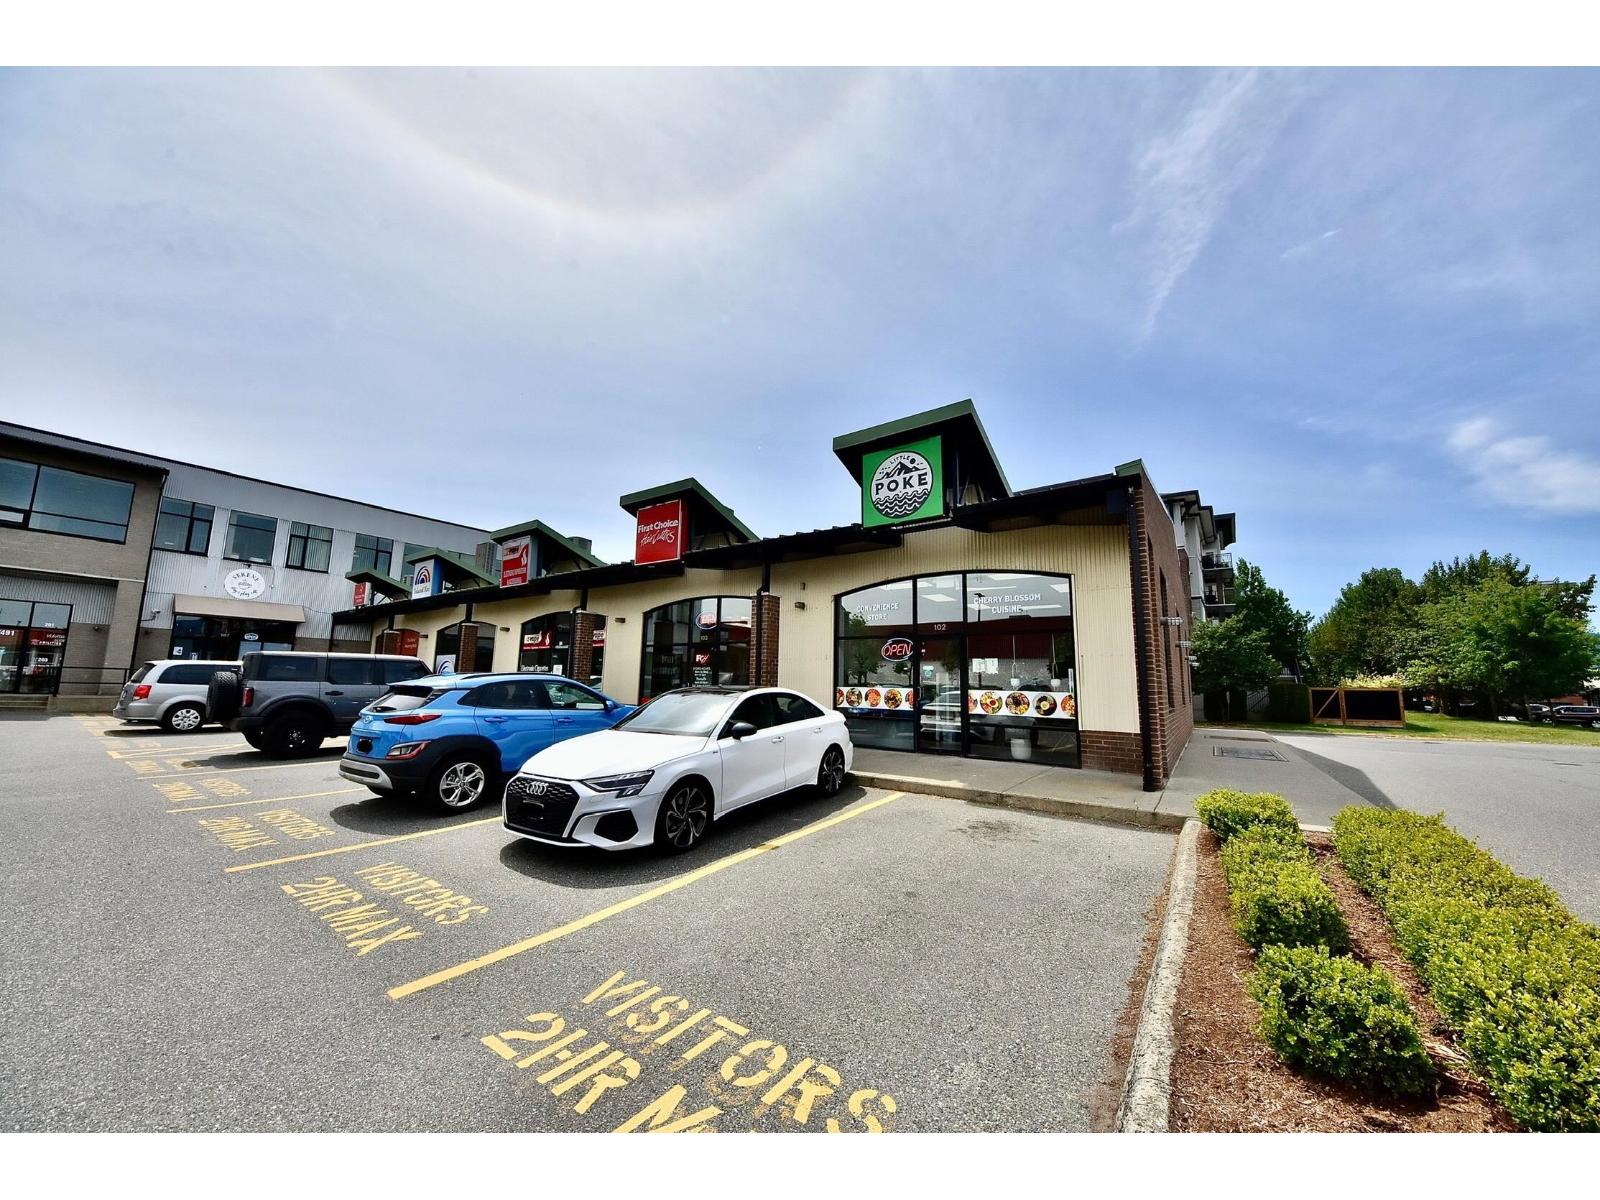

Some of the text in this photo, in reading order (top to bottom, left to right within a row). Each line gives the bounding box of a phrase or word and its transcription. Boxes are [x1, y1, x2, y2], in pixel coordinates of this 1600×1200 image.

[889, 455, 911, 465] LITTLE
[875, 471, 928, 496] POKE
[638, 519, 678, 534] First Choice
[973, 593, 1041, 605] CHERRY BLOSSOM
[856, 602, 899, 613] CONVENIENCE
[991, 604, 1022, 614] CUISINE
[867, 613, 888, 621] STORE
[933, 623, 947, 631] 102
[884, 643, 912, 656] OPEN
[354, 861, 489, 925] VISITORS
[320, 902, 423, 957] MAX
[581, 970, 897, 1133] VISITORS
[480, 1012, 642, 1115] 2HR
